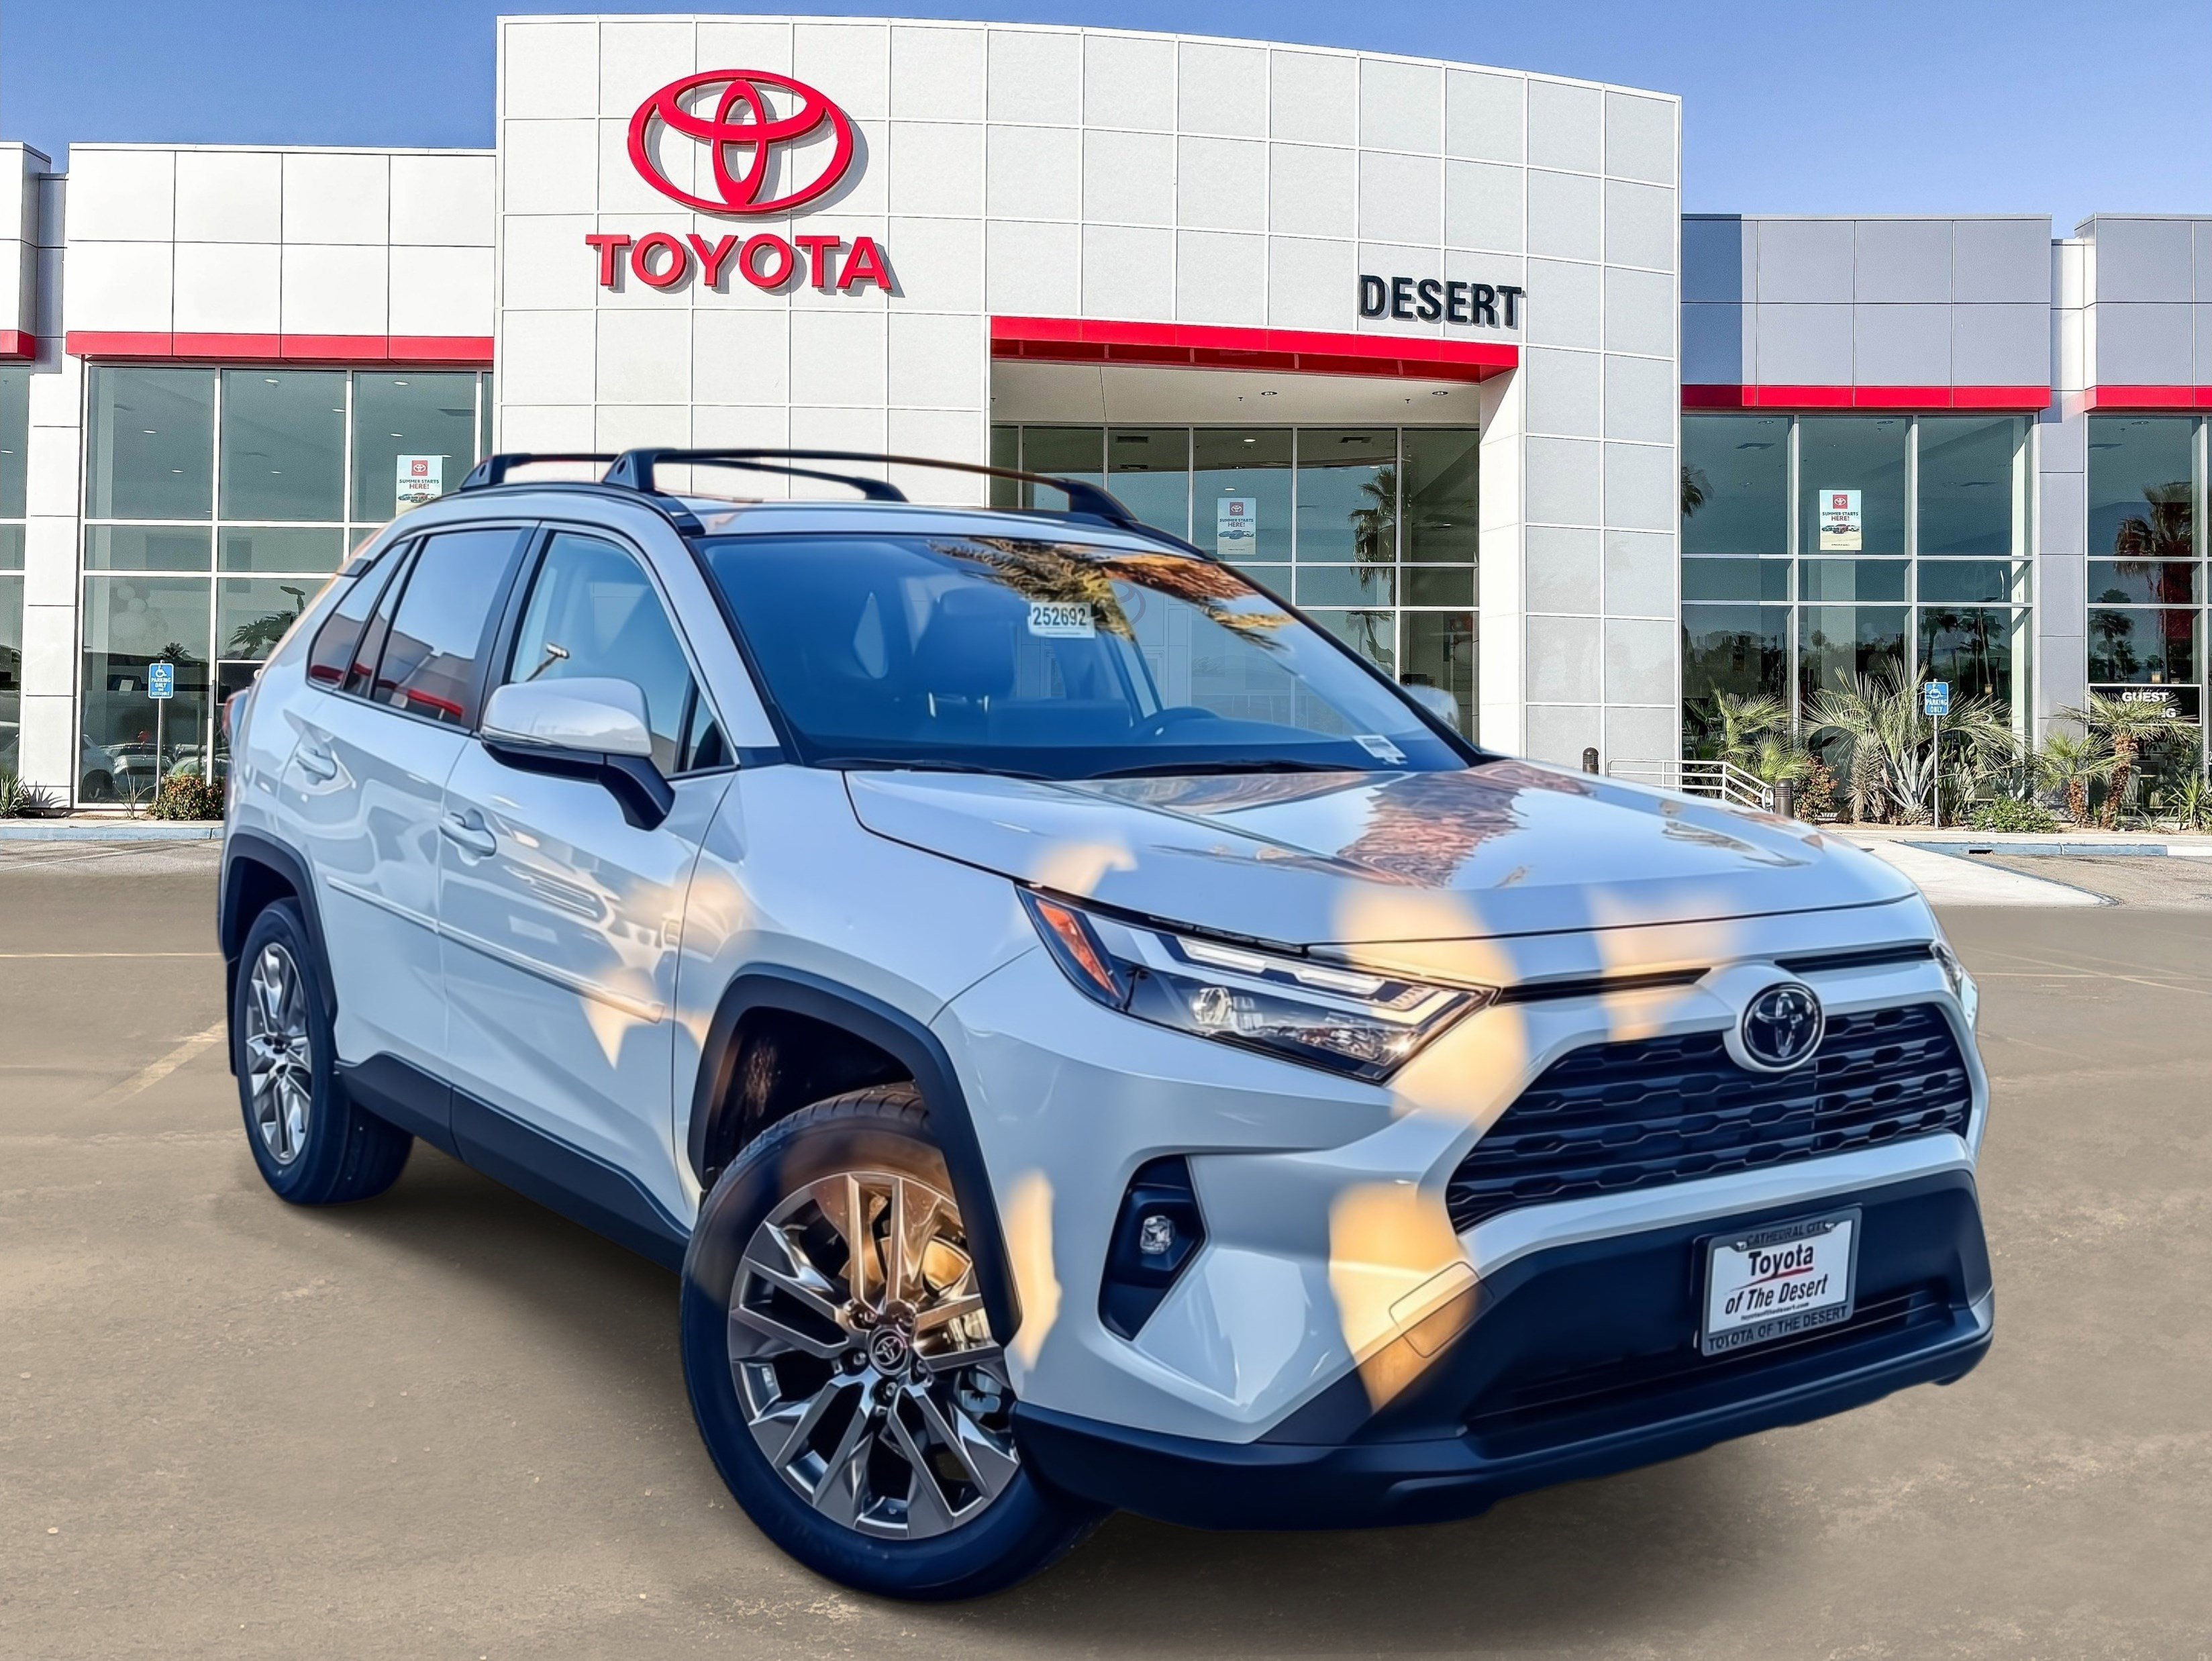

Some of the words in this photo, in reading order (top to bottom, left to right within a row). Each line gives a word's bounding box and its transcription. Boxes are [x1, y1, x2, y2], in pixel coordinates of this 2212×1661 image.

[585, 232, 893, 291] TOYOTA
[1359, 274, 1522, 327] DESERT
[1033, 607, 1087, 626] 252692
[2122, 692, 2169, 702] GUEST
[1747, 1224, 1804, 1246] CATHEDRAL
[1748, 1244, 1813, 1277] Toyota
[1725, 1291, 1744, 1315] of
[1746, 1287, 1774, 1311] The
[1778, 1273, 1828, 1303] Desert
[1709, 1328, 1754, 1352] TOYOTA
[1758, 1322, 1774, 1338] OF
[1778, 1317, 1800, 1334] THE
[1803, 1305, 1848, 1327] DESERT
